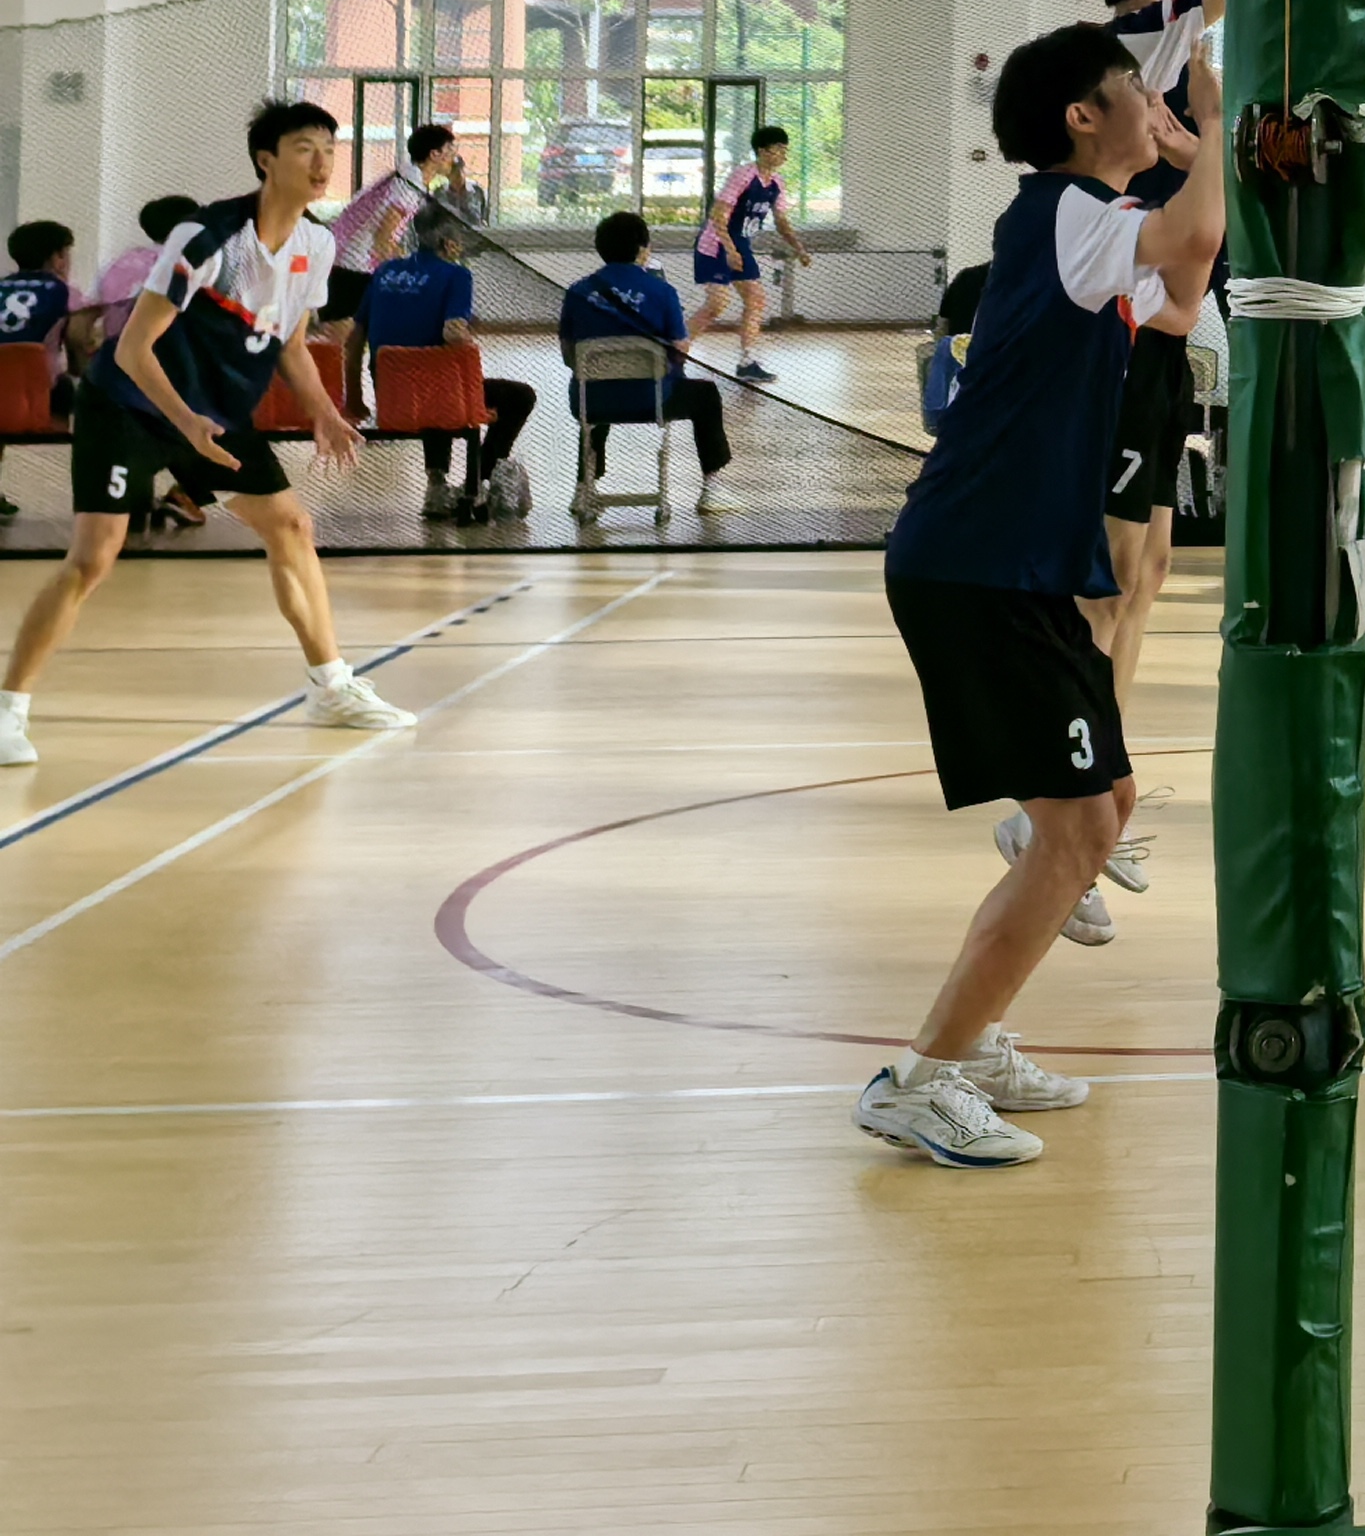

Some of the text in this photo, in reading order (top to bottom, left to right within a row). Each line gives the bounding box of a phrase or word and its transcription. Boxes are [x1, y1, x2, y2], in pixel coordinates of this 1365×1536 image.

[108, 465, 128, 500] 5
[1112, 449, 1143, 494] 7
[1069, 717, 1094, 770] 3
